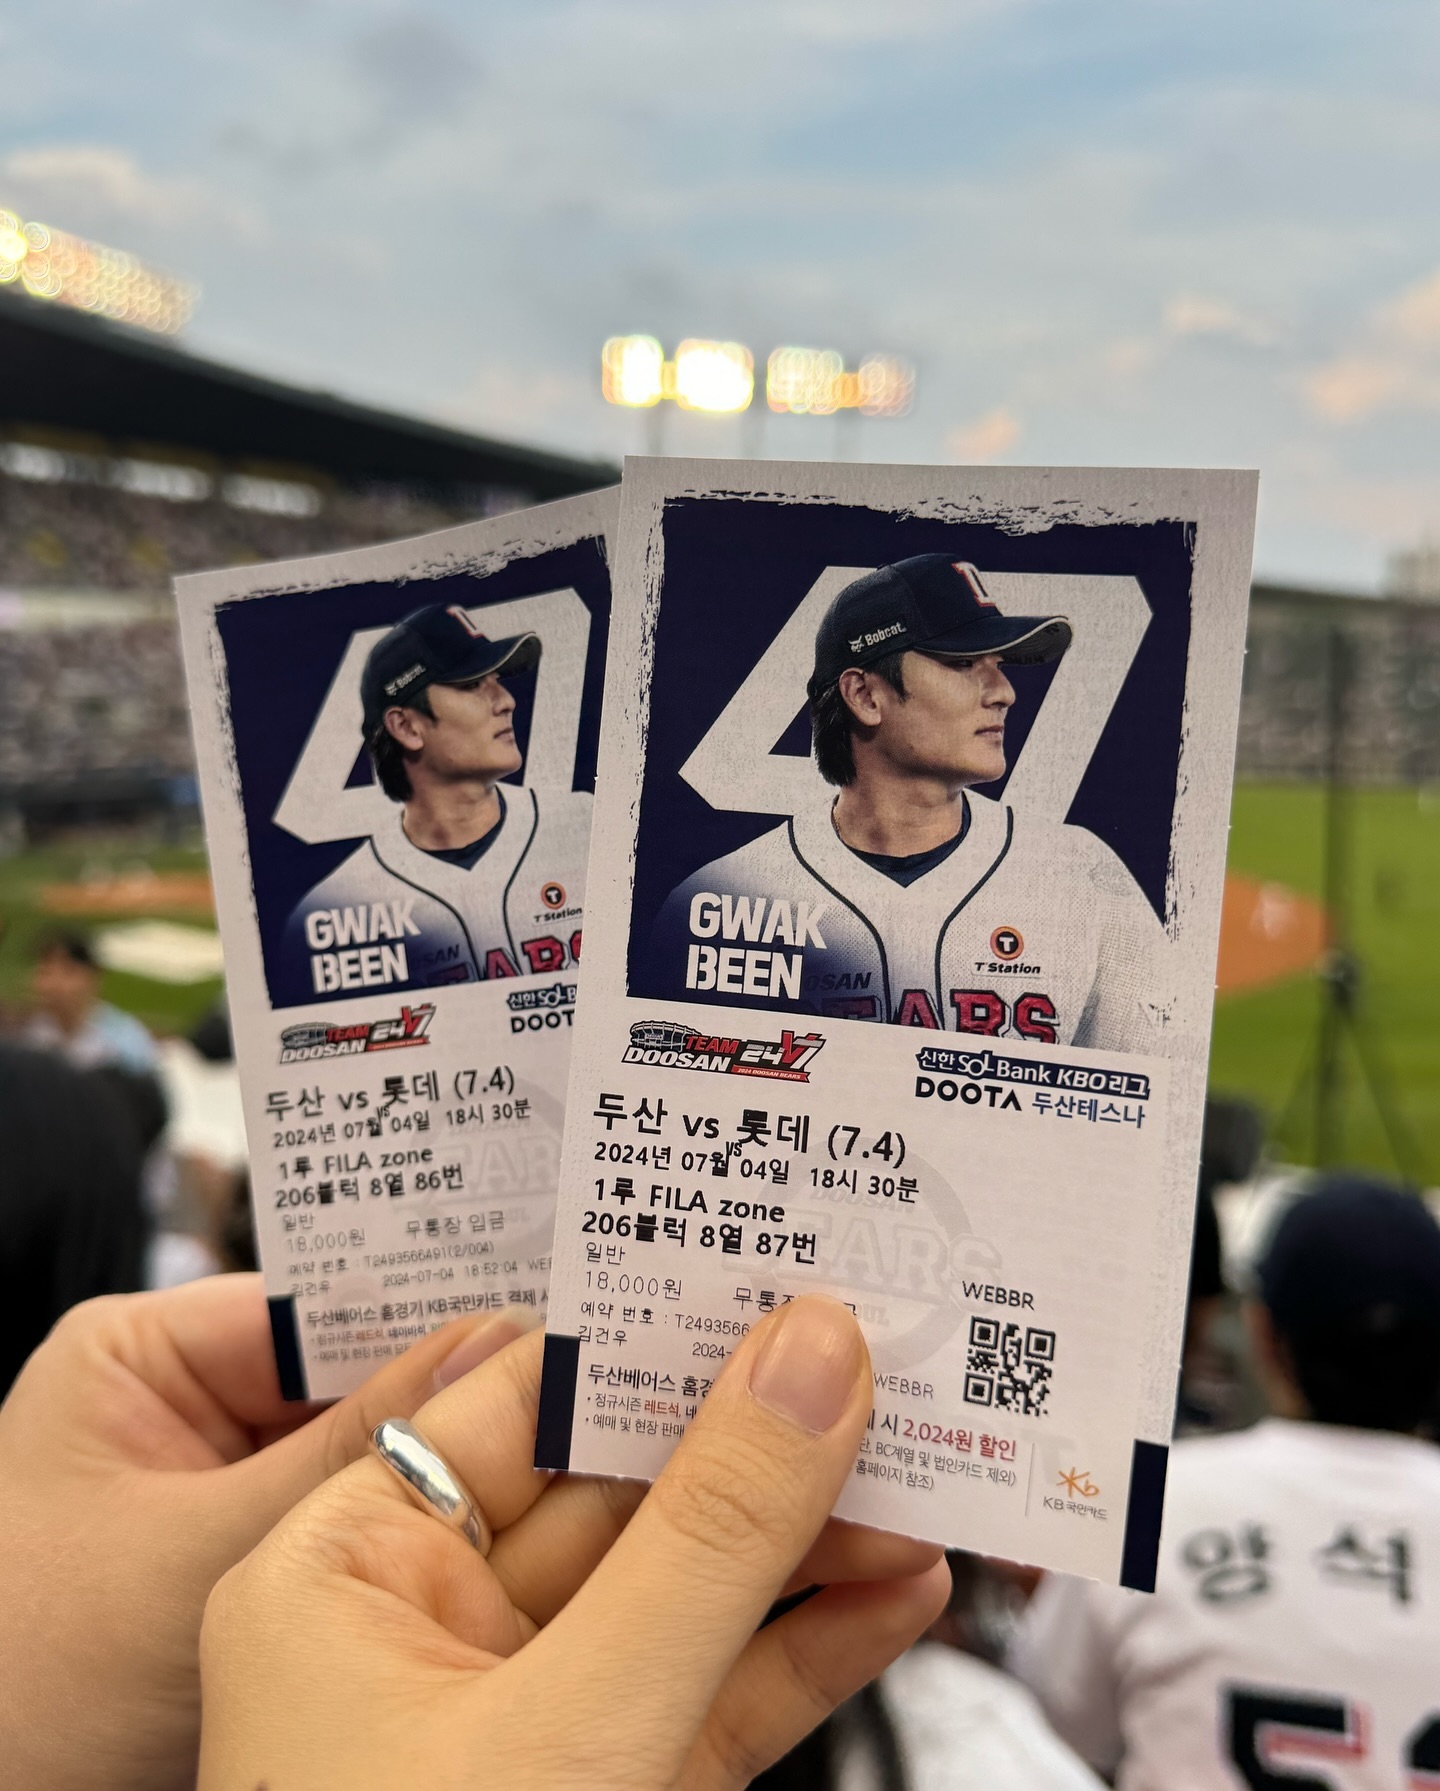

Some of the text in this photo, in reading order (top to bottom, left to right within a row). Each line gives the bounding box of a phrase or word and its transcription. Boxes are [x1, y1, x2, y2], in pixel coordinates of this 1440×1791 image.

[864, 621, 907, 647] Bobcat
[305, 900, 421, 950] GWAK
[544, 907, 583, 922] Station
[689, 891, 828, 950] GWAK
[311, 943, 410, 994] BEEN
[686, 944, 804, 1000] BEEN
[988, 962, 1041, 974] Station
[326, 1024, 370, 1043] TEAM
[510, 1009, 575, 1033] DOOT
[280, 1040, 366, 1063] DOOSAN
[622, 1047, 732, 1072] DOOSAN
[686, 1035, 741, 1054] TEAM
[919, 1050, 956, 1071] 신한
[996, 1060, 1052, 1083] Bank
[1056, 1068, 1107, 1091] KBO
[1108, 1075, 1148, 1096] 리그
[266, 1065, 516, 1121] 두산 vs 롯데 (7.4)
[915, 1076, 1146, 1129] DOOTA 두산테스나
[274, 1123, 337, 1148] 2024년
[343, 1115, 384, 1139] 07월
[390, 1109, 431, 1133] 04일
[446, 1103, 485, 1126] 18시
[491, 1097, 532, 1121] 30분
[593, 1092, 907, 1169] 두산 vs 롯데 (7.4)
[279, 1147, 434, 1181] 1루 FILA zone
[593, 1141, 920, 1204] 2024년 07월 04일 18시 30분
[275, 1162, 465, 1209] 206블럭 8열 86번
[594, 1178, 786, 1222] 1루 FILA zone
[281, 1213, 315, 1232] 일반
[287, 1228, 367, 1254] 18,000원
[405, 1216, 462, 1240] 무통장
[468, 1209, 506, 1232] 입금
[582, 1211, 817, 1265] 206블럭 8열 87번
[585, 1241, 627, 1266] 일반
[383, 1269, 455, 1288] 2024-07-04
[463, 1259, 518, 1278] 18:52:04
[585, 1269, 683, 1301] 18,000원
[307, 1305, 377, 1328] 두산베어스
[381, 1300, 425, 1321] 홈경기
[427, 1291, 505, 1315] KB국민카드
[961, 1280, 1037, 1311] WEBBR
[580, 1300, 615, 1320] 예약
[622, 1305, 655, 1325] 번호
[577, 1324, 629, 1347] 김건우
[587, 1363, 677, 1393] 두산베어스
[873, 1371, 936, 1401] WEBBR
[593, 1391, 643, 1412] 정규시즌
[643, 1398, 682, 1419] 레드석,
[592, 1413, 686, 1439] 예매 및 현장 판매
[880, 1413, 899, 1436] 시
[902, 1418, 974, 1455] 2,024원
[978, 1432, 1017, 1463] 할인
[855, 1458, 935, 1491] 홈페이지 참조)
[875, 1440, 915, 1465] BC계열
[917, 1451, 931, 1468] 및
[933, 1454, 984, 1479] 법인카드
[985, 1466, 1018, 1488] 제외)
